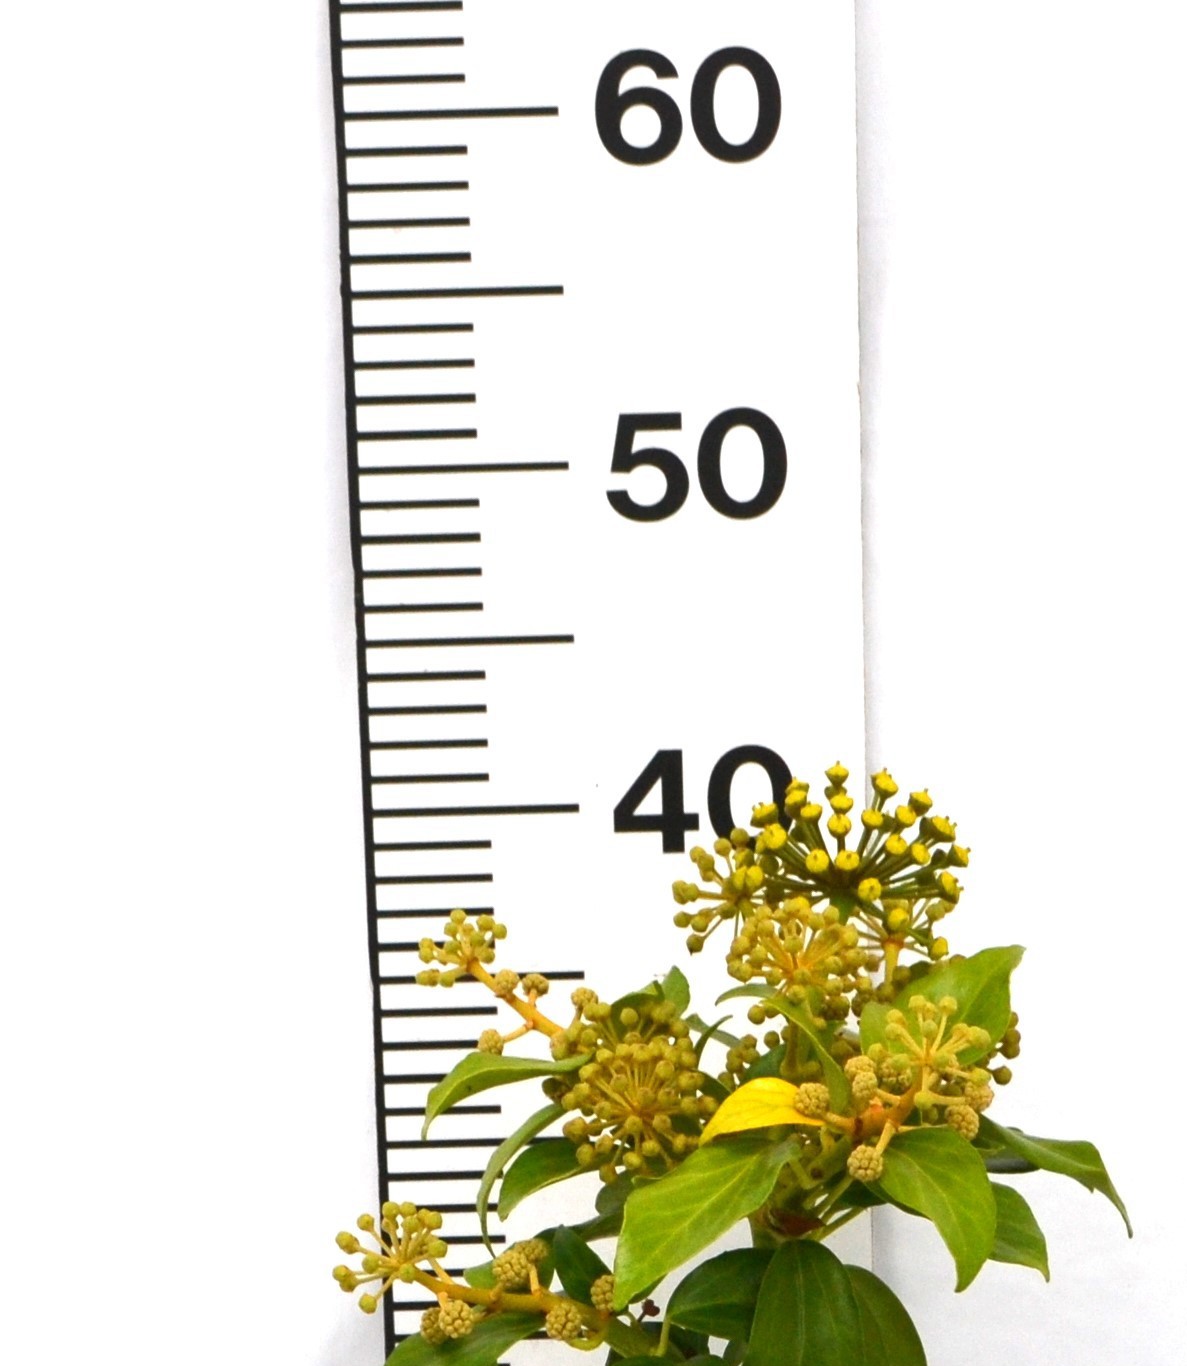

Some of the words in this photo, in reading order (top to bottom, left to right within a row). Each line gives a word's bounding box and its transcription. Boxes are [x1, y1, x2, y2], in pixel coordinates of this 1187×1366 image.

[594, 46, 782, 167] 60
[605, 407, 788, 523] 50
[613, 743, 795, 855] 40
